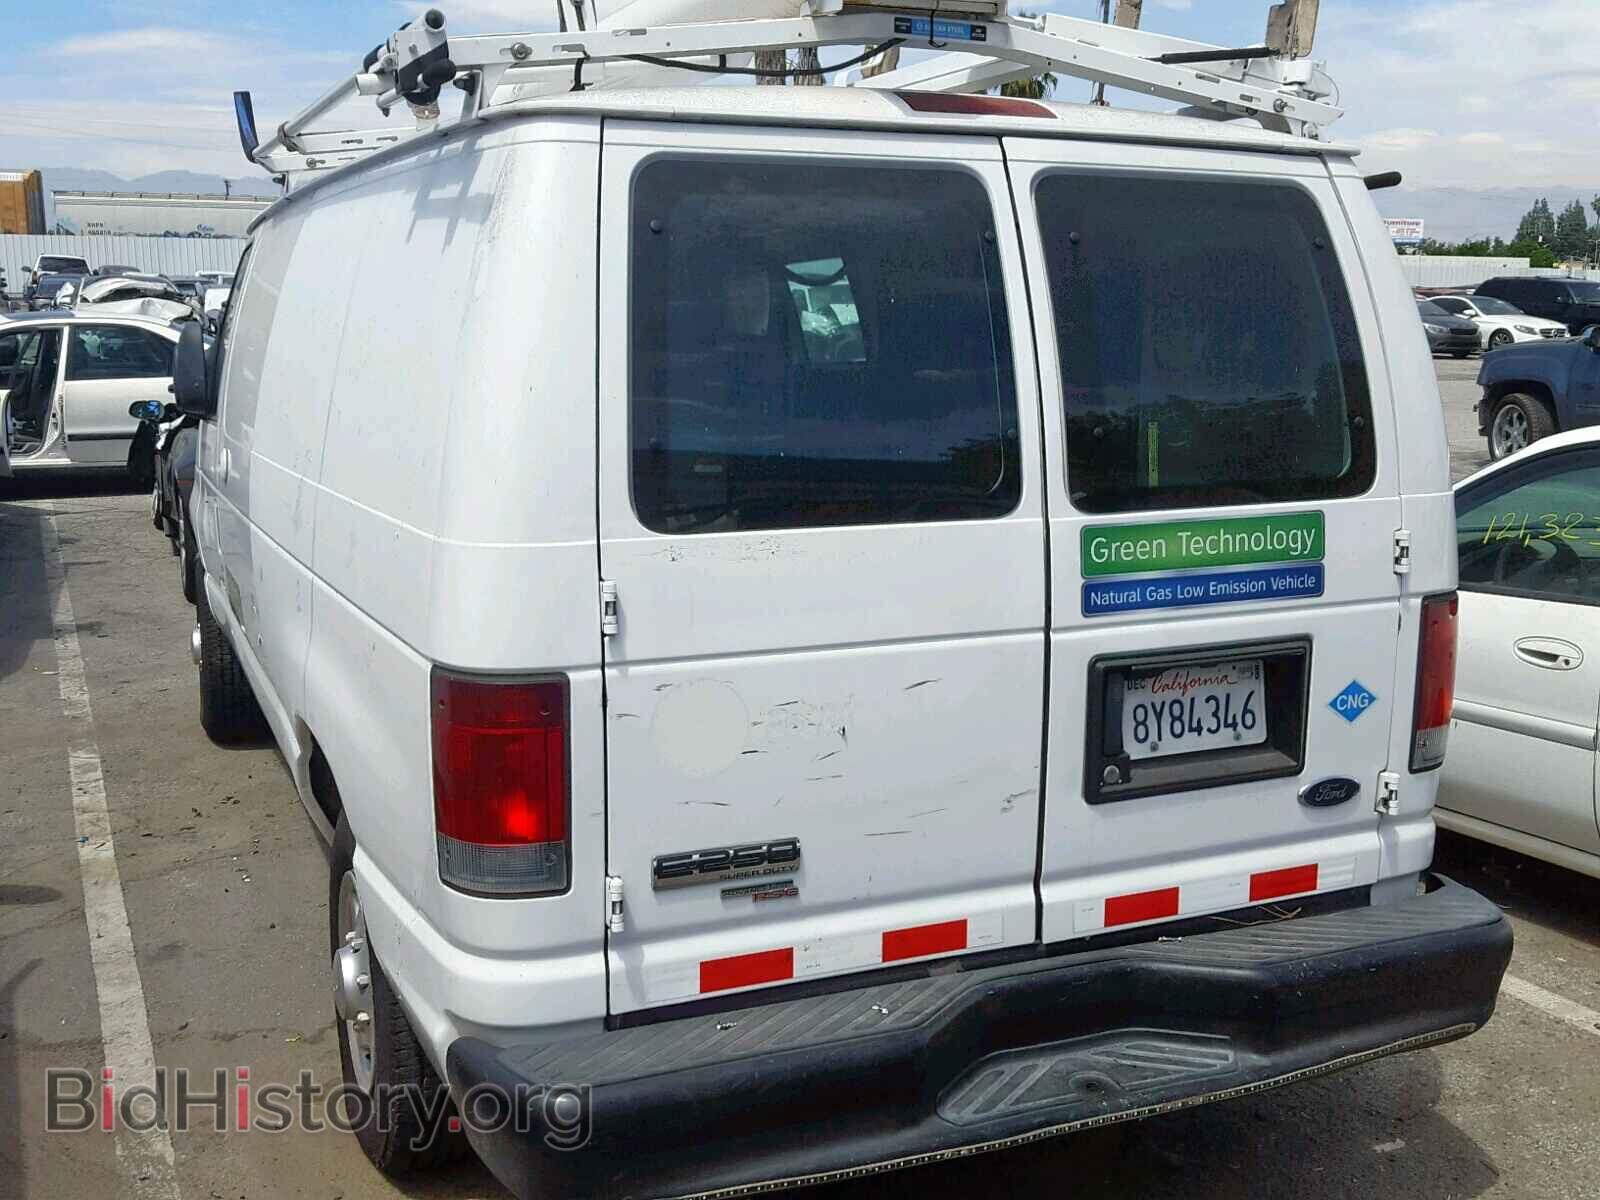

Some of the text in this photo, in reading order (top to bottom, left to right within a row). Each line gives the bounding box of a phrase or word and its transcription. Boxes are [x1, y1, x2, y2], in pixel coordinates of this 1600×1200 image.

[1090, 525, 1316, 564] Green Technology
[1483, 512, 1600, 547] 121,32
[1090, 573, 1316, 606] Natural Gas Low Emission Vehicle
[1152, 671, 1238, 697] California
[1132, 690, 1257, 744] 8Y84346
[1336, 693, 1369, 711] CNG
[1315, 783, 1348, 802] Ford
